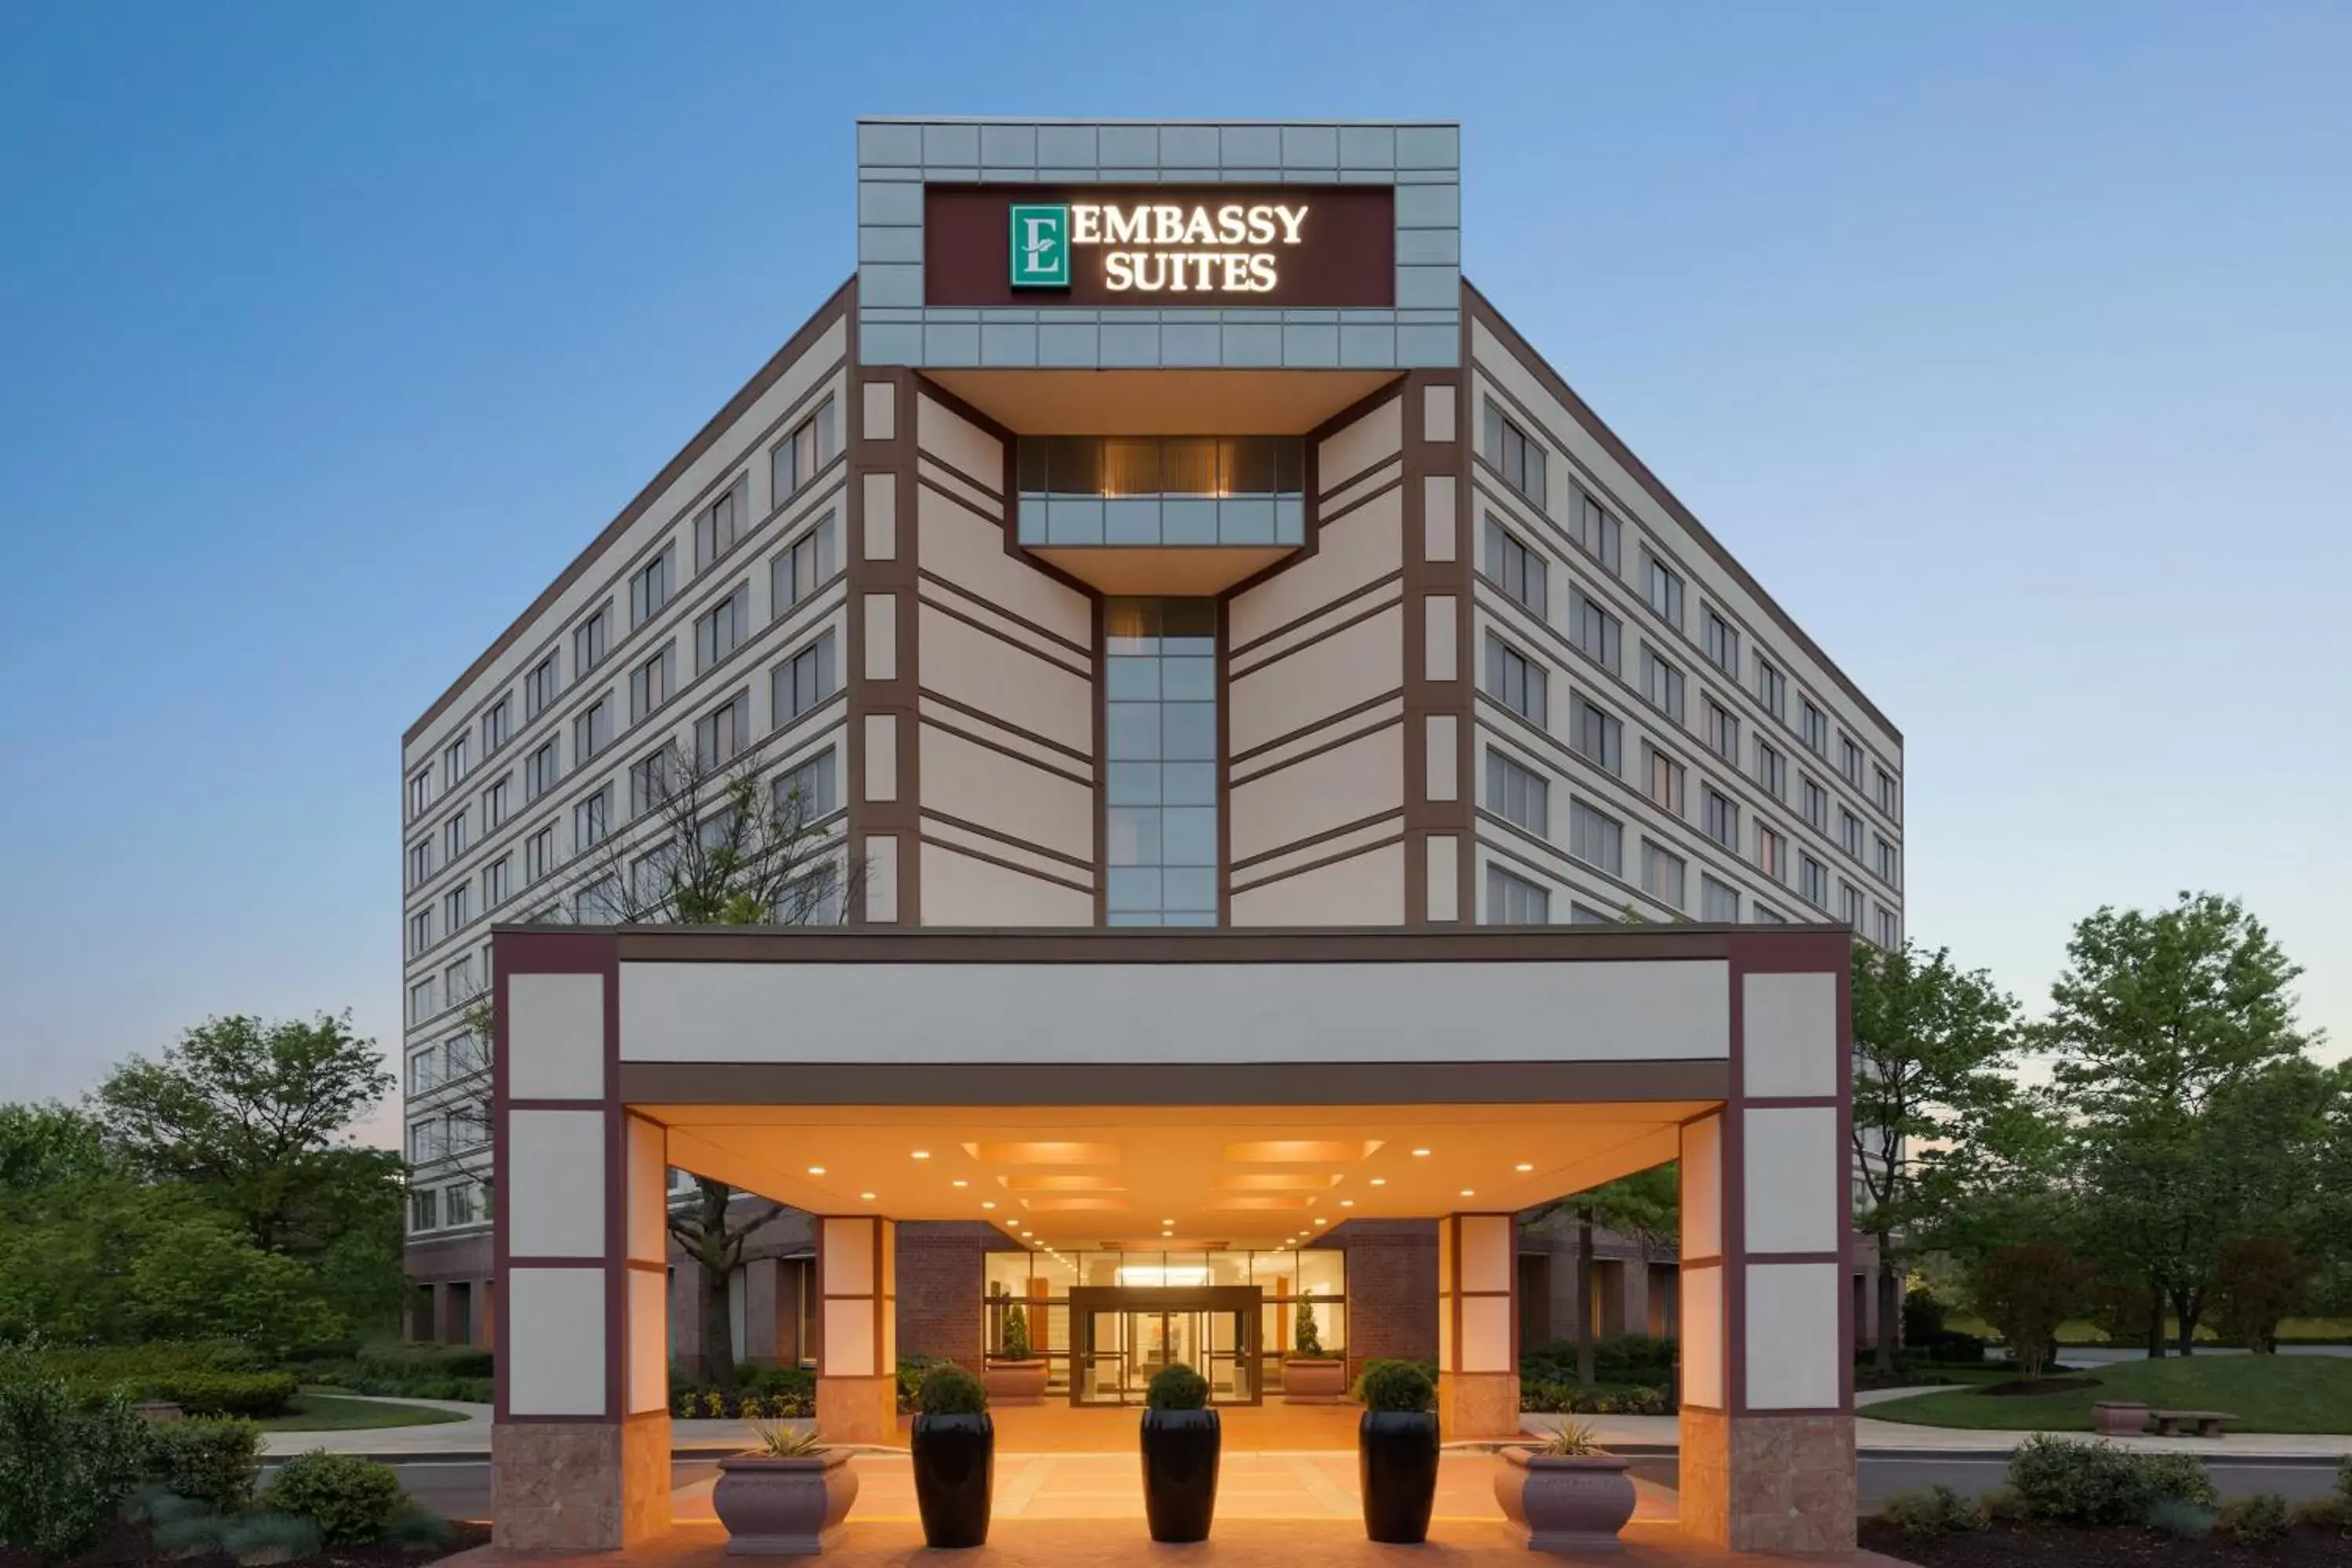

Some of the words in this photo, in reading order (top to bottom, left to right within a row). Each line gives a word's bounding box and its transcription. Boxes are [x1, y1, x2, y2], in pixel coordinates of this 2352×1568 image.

[1071, 205, 1308, 245] EMBASSY
[1022, 218, 1058, 273] E
[1105, 252, 1277, 292] SUITES
